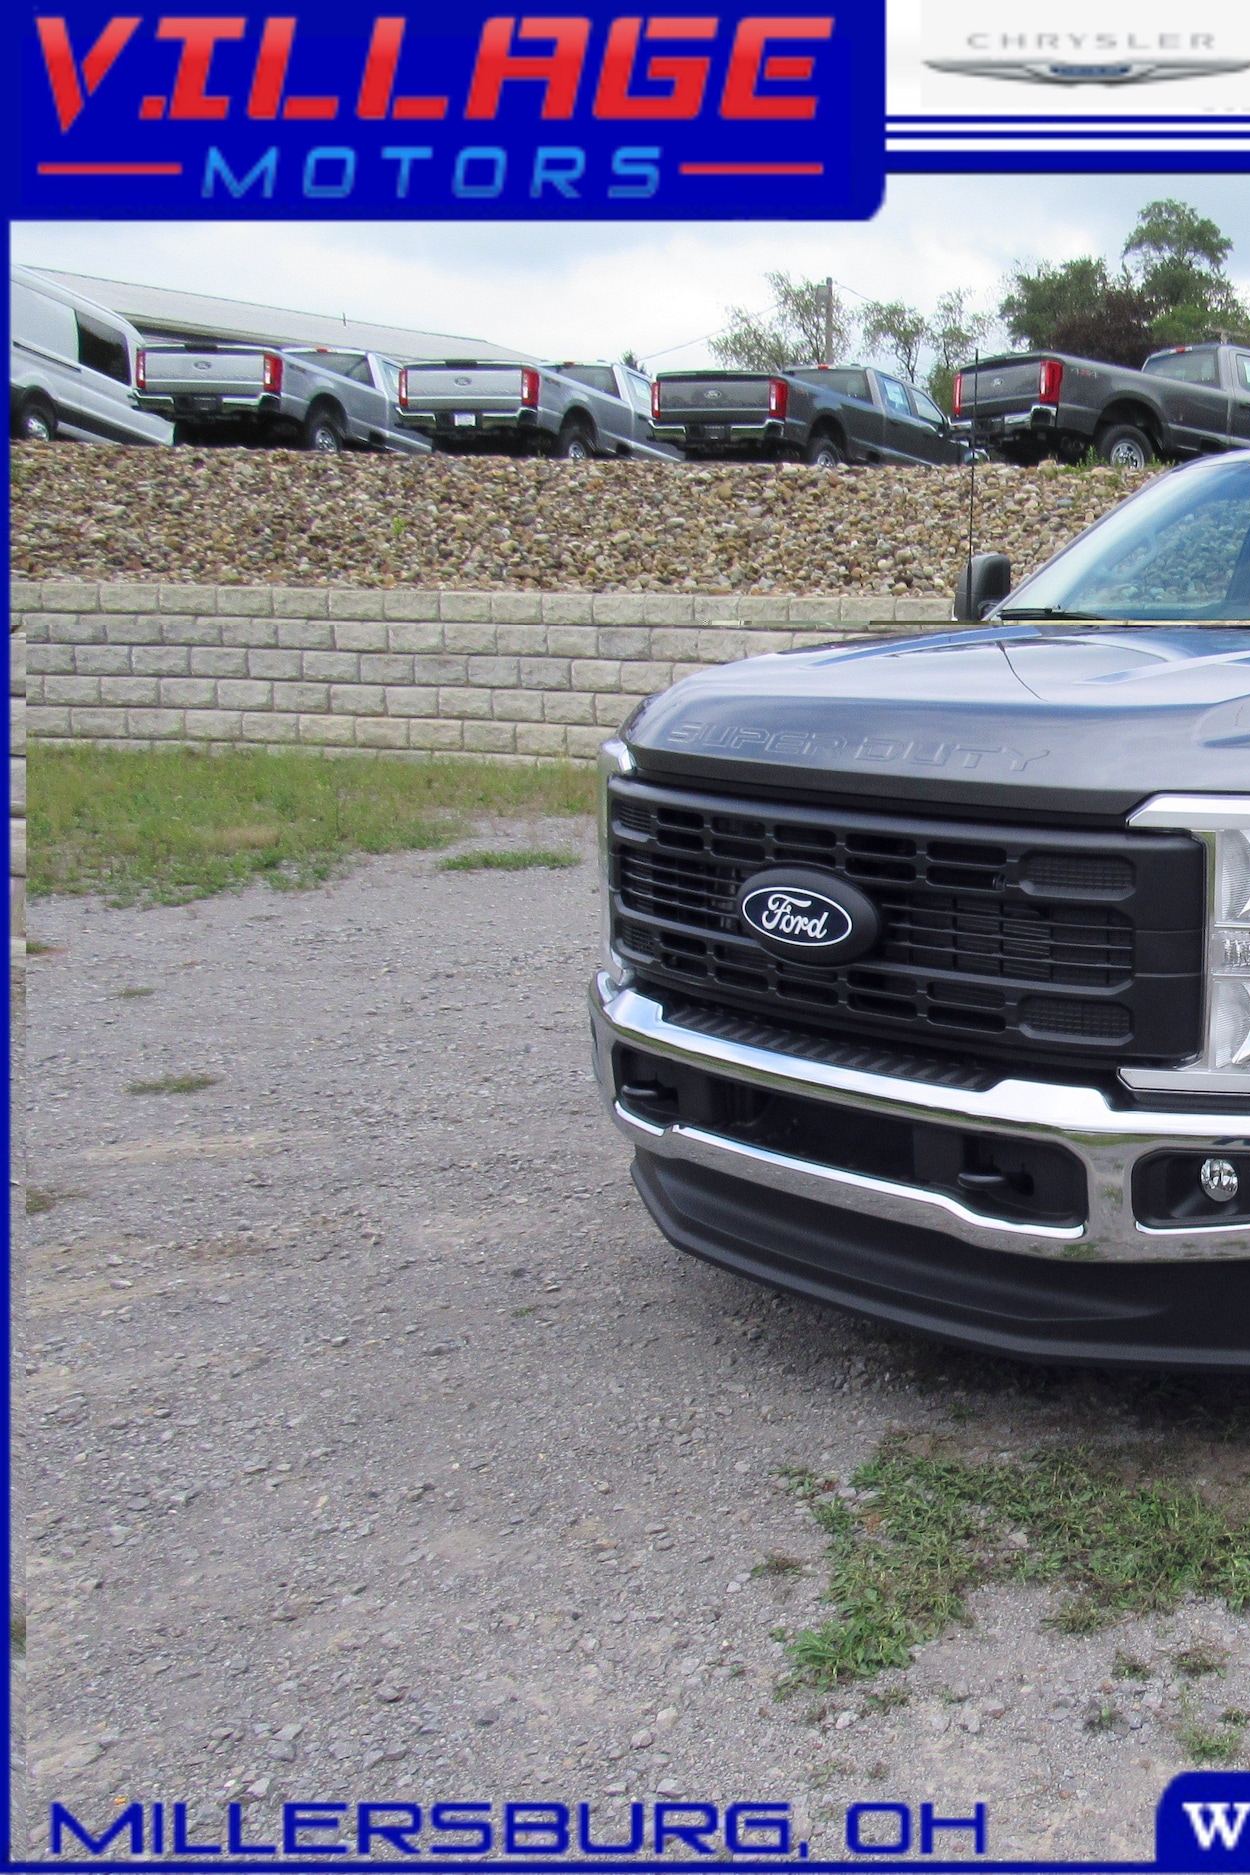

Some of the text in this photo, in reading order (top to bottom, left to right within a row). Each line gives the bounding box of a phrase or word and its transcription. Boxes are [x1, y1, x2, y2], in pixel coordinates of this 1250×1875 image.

[666, 719, 1051, 773] SUPER DUTY
[761, 892, 829, 939] Ford
